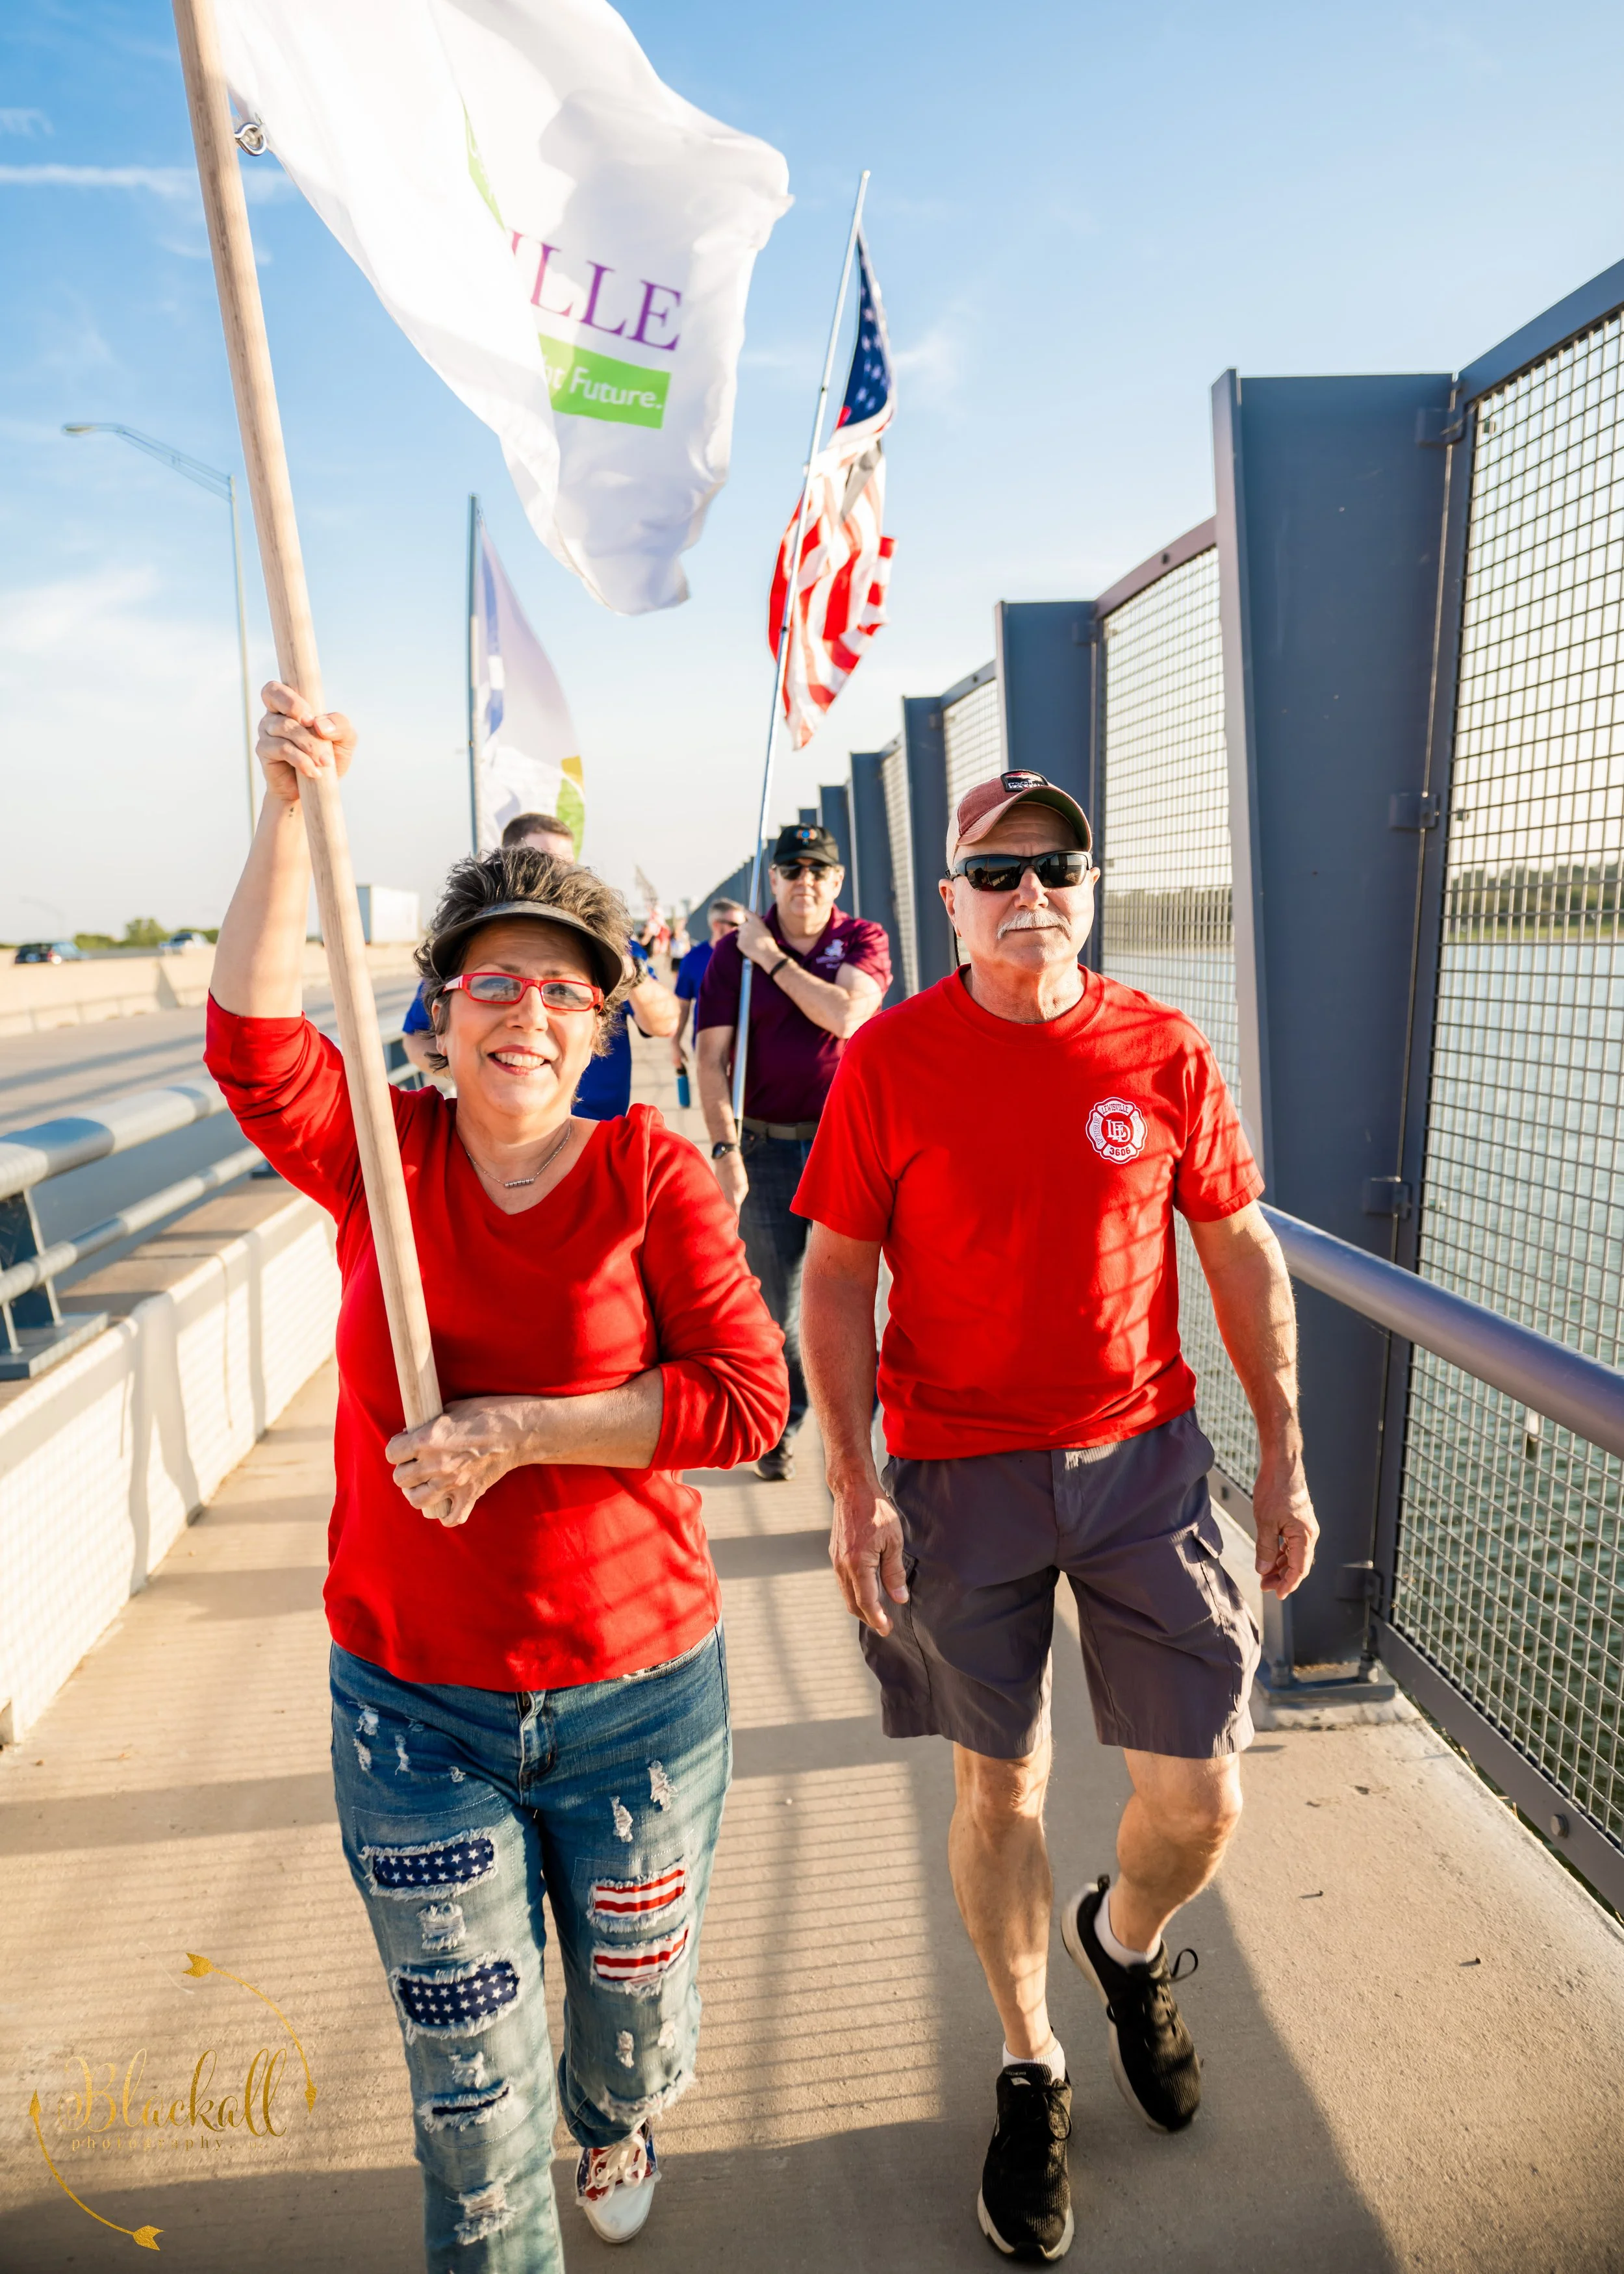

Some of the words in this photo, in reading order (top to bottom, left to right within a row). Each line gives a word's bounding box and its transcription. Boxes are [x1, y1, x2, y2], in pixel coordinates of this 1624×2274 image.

[569, 366, 663, 409] Future.
[1102, 1104, 1129, 1114] LEWISVILLE
[1093, 1116, 1103, 1145] FIRE
[1110, 1147, 1130, 1156] 3606
